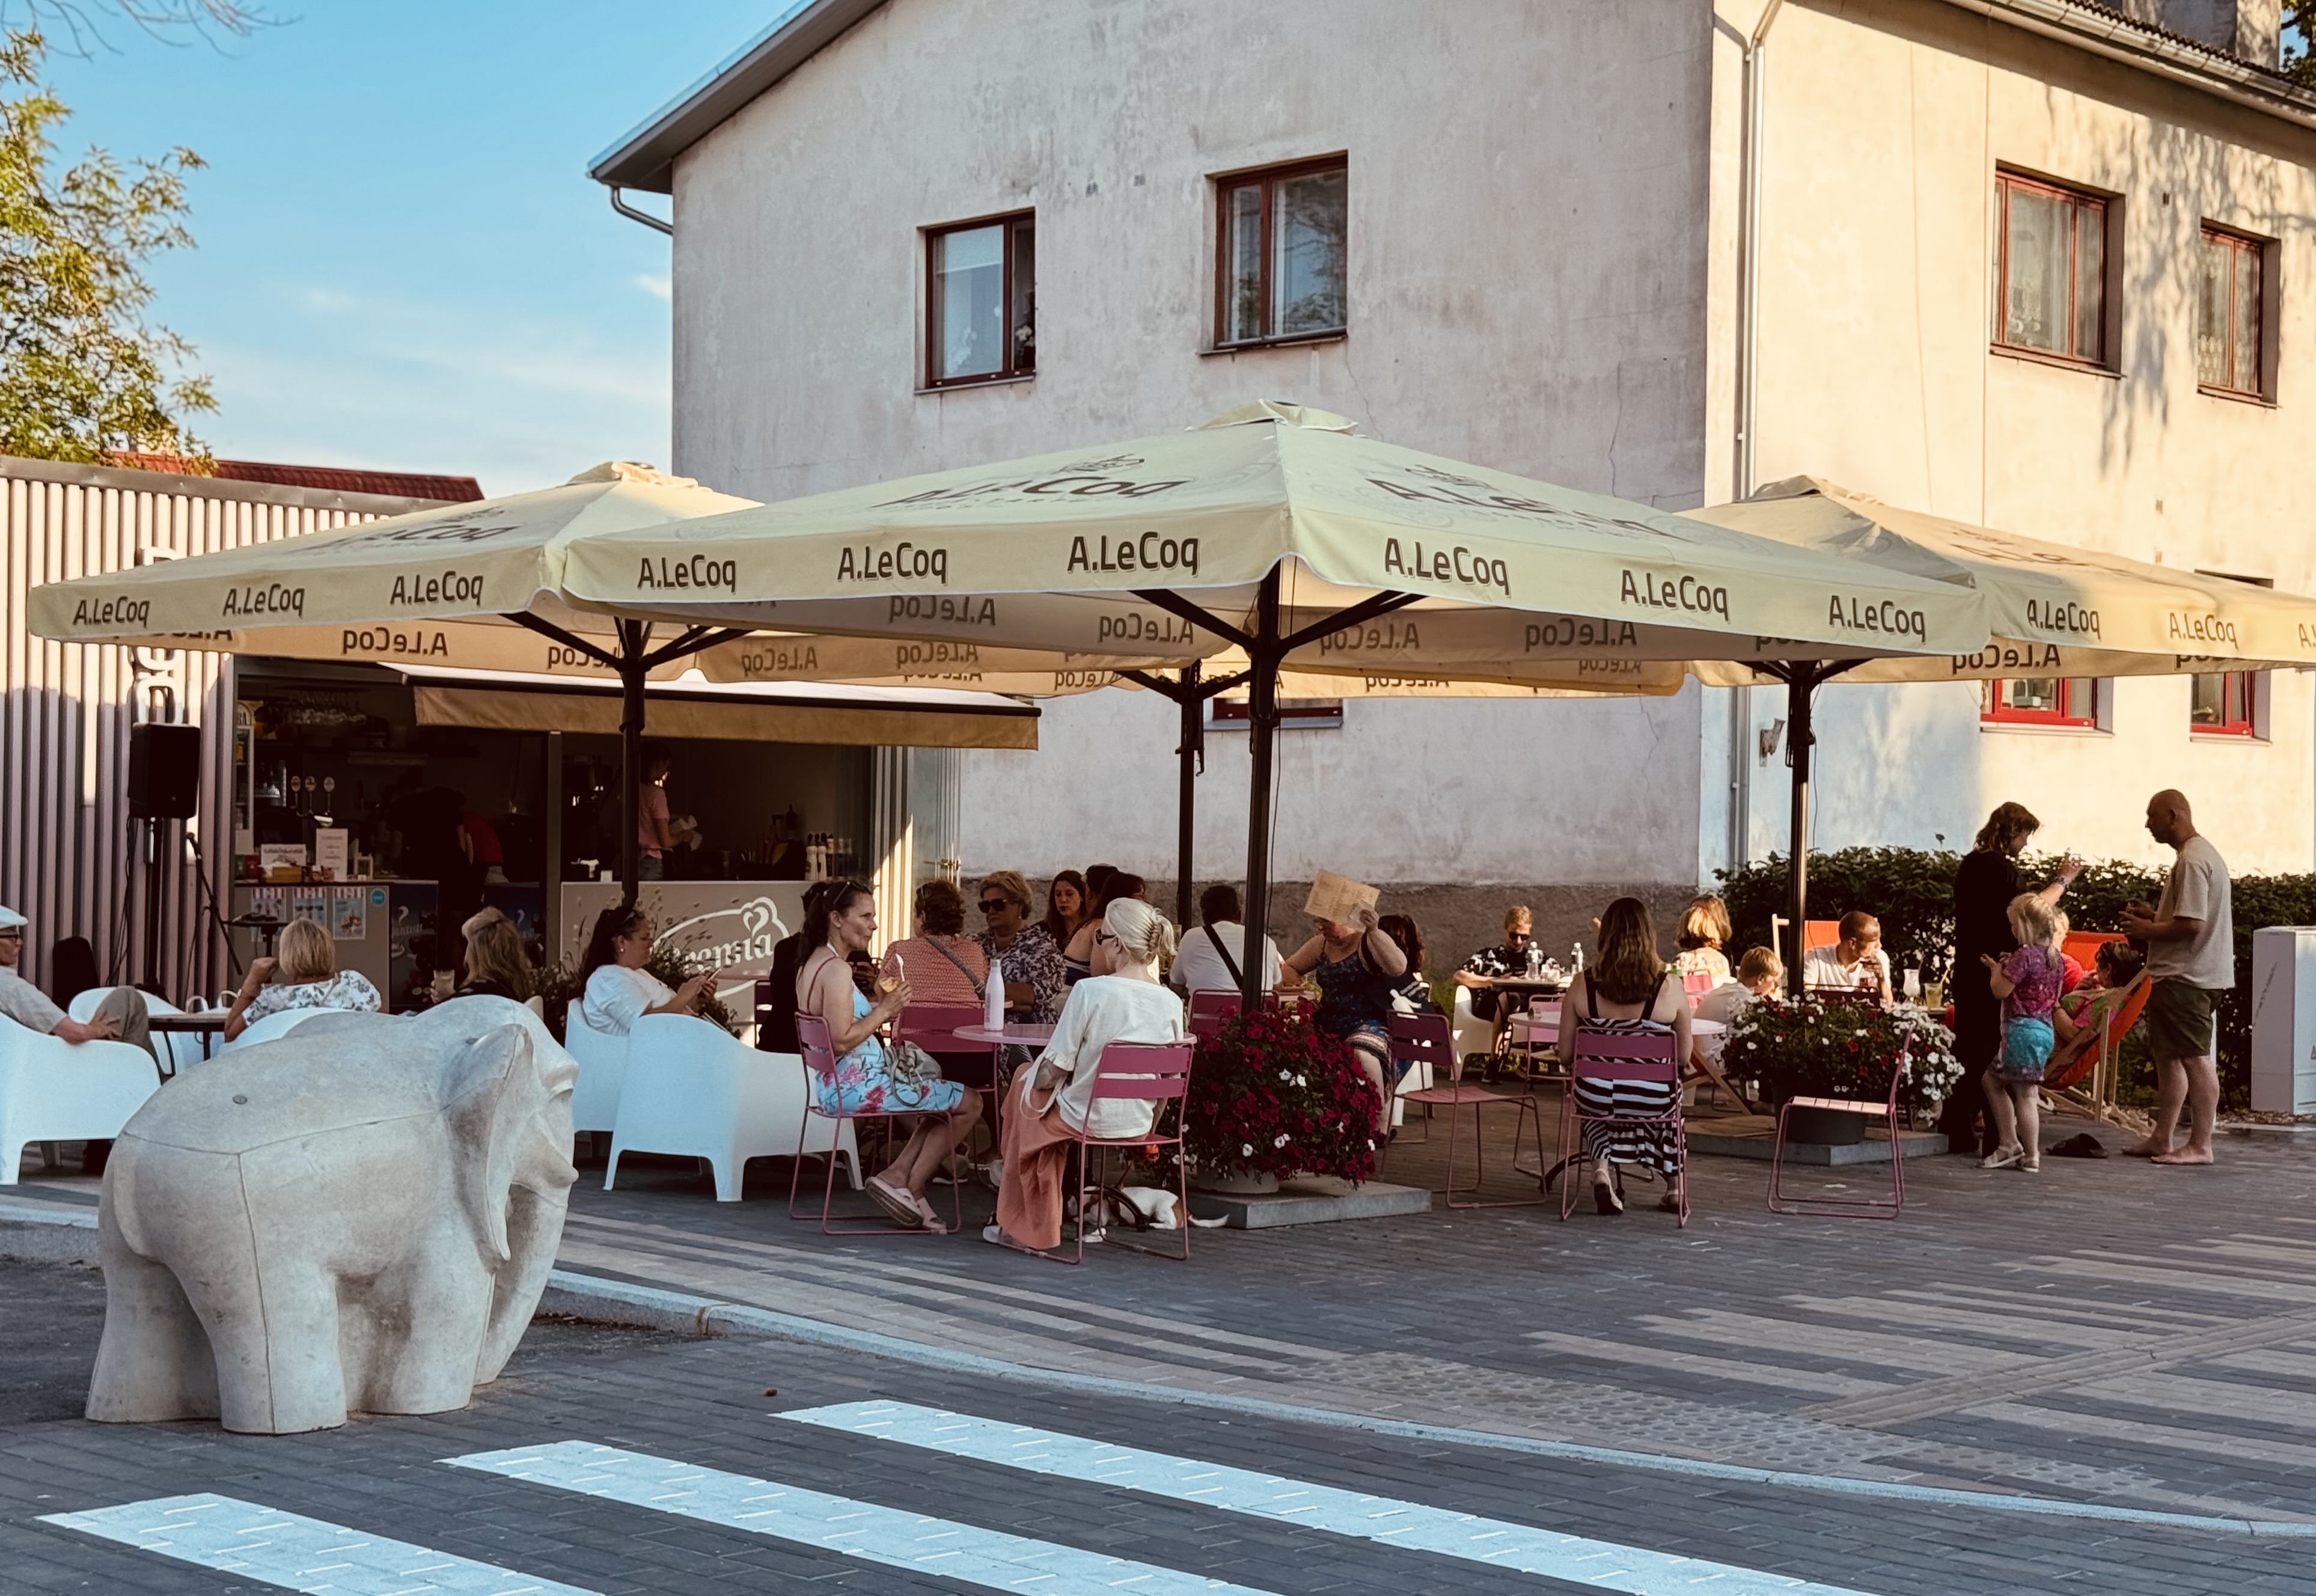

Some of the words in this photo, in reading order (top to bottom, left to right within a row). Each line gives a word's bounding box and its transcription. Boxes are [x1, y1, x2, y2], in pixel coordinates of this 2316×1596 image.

[637, 554, 736, 592] A.LeCoq
[837, 542, 948, 584] A.LeCoq
[1067, 531, 1200, 575] A.LeCoq
[1385, 538, 1511, 595] A.LeCoq
[222, 582, 305, 618] A.LeCoq
[390, 570, 483, 605] A.LeCoq
[1621, 570, 1730, 622] A.LeCoq
[73, 596, 150, 629] A.LeCoq
[1829, 595, 1926, 643] A.LeCoq
[2027, 599, 2101, 642] A.LeCoq
[2169, 612, 2239, 650] A.LeCoq
